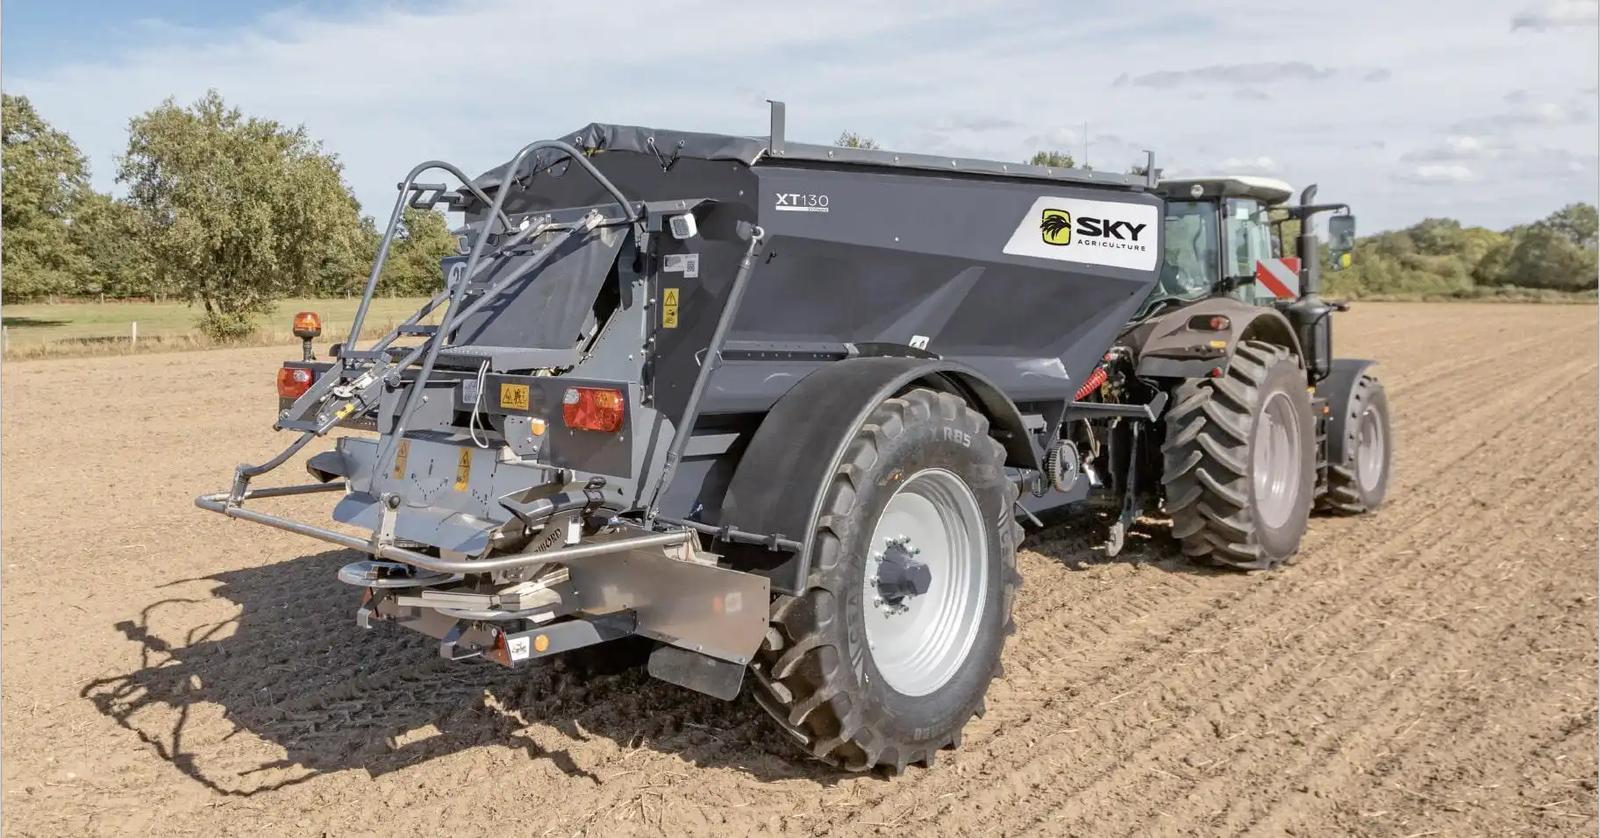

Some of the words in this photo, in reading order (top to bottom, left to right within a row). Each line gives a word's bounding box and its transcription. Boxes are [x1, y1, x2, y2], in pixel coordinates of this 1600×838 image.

[776, 193, 829, 207] XT130
[1076, 217, 1147, 242] SKY
[1077, 239, 1146, 252] AGRICULTURE
